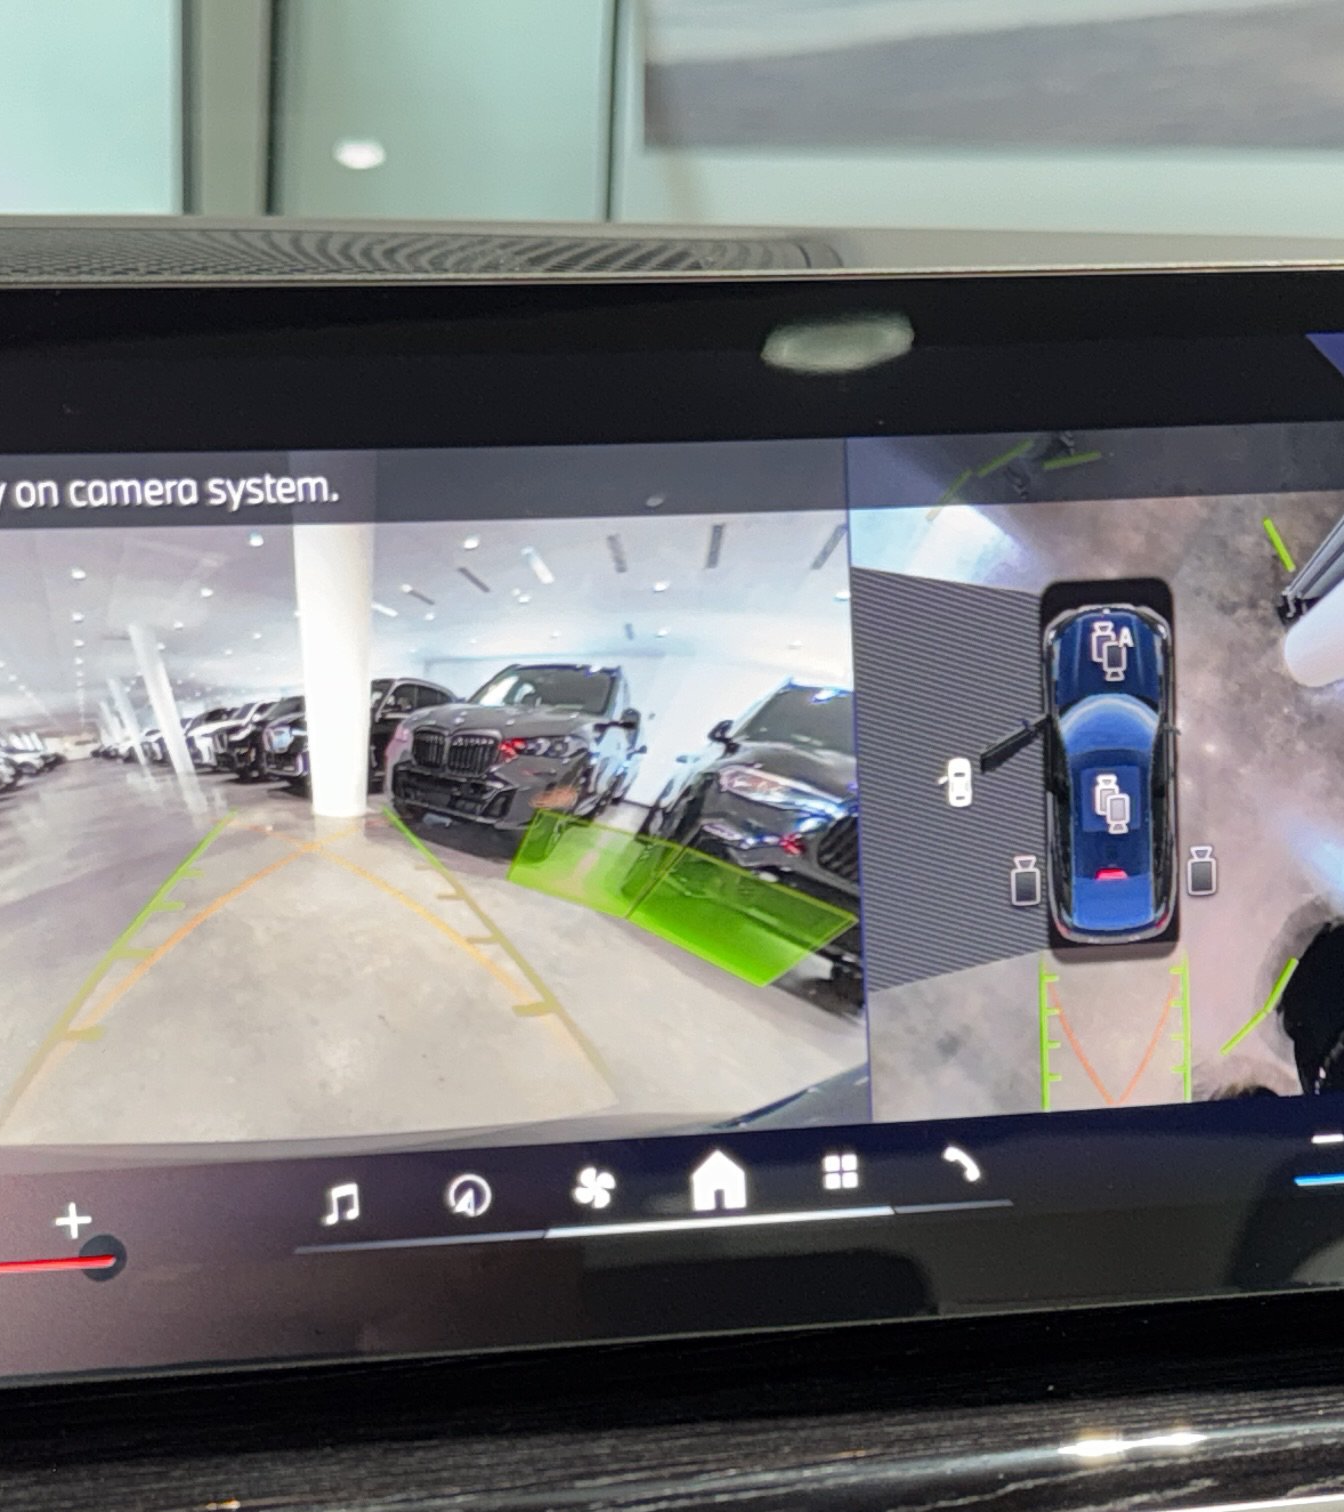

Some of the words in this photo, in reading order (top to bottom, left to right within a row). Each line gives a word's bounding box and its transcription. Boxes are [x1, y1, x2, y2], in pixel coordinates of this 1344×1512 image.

[16, 479, 57, 509] on
[68, 478, 197, 507] camera
[208, 473, 340, 512] system.
